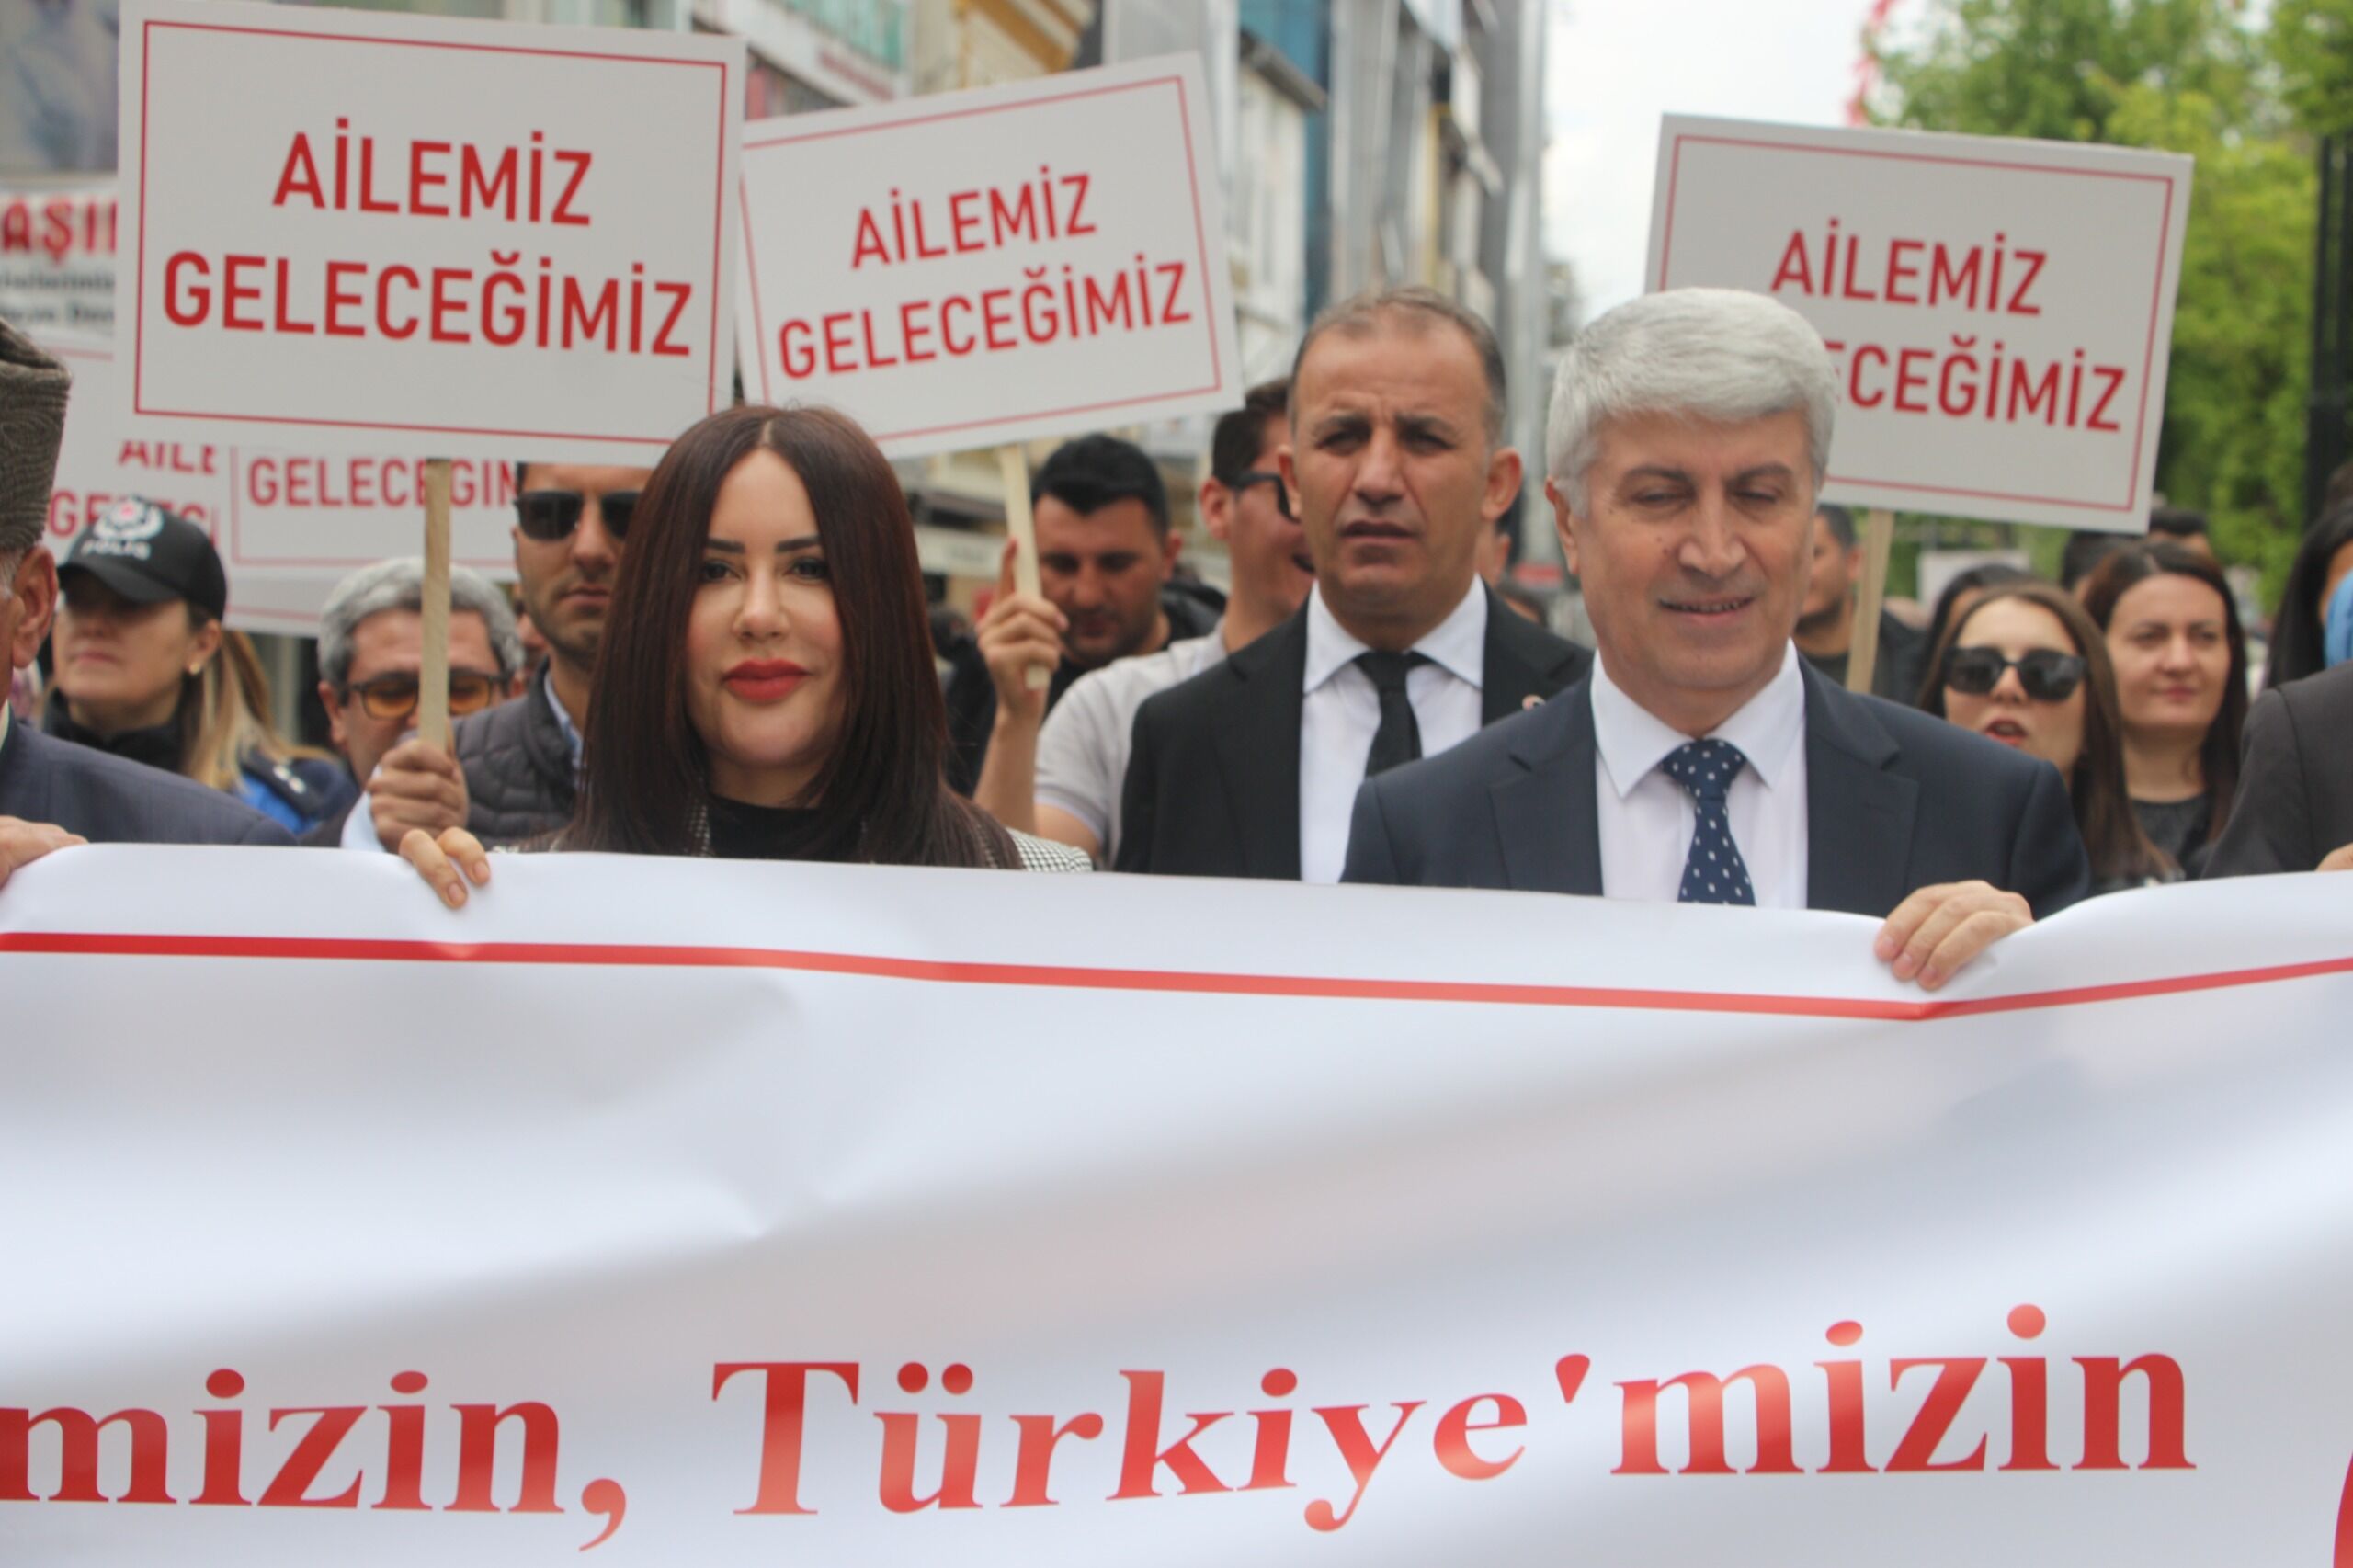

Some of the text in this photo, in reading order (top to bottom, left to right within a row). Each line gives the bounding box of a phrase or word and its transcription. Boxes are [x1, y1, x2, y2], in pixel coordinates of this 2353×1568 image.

[272, 117, 594, 226] AİLEMİZ
[851, 164, 1098, 269] AİLEMİZ
[164, 248, 694, 358] GELECEĞİMİZ
[778, 253, 1193, 381] GELECEĞİMİZ
[1769, 217, 2048, 317] AİLEMİZ
[1824, 332, 2126, 433] CEĞİMİZ
[0, 1303, 2197, 1551] mizin, Türkiye'mizin
